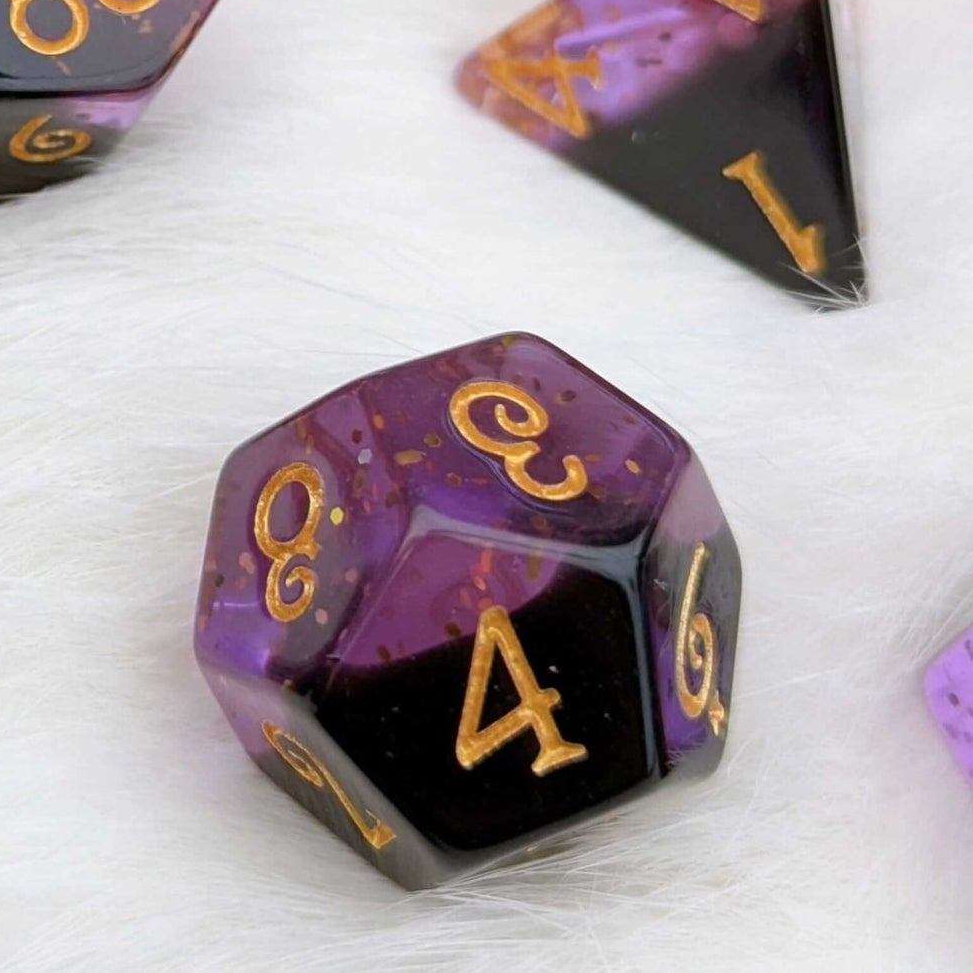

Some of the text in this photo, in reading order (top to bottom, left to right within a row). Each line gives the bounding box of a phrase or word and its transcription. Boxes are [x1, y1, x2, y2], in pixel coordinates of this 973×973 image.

[485, 45, 603, 138] 4
[722, 150, 824, 273] 1
[449, 380, 589, 501] 3
[253, 462, 325, 623] 8
[455, 605, 589, 778] 4
